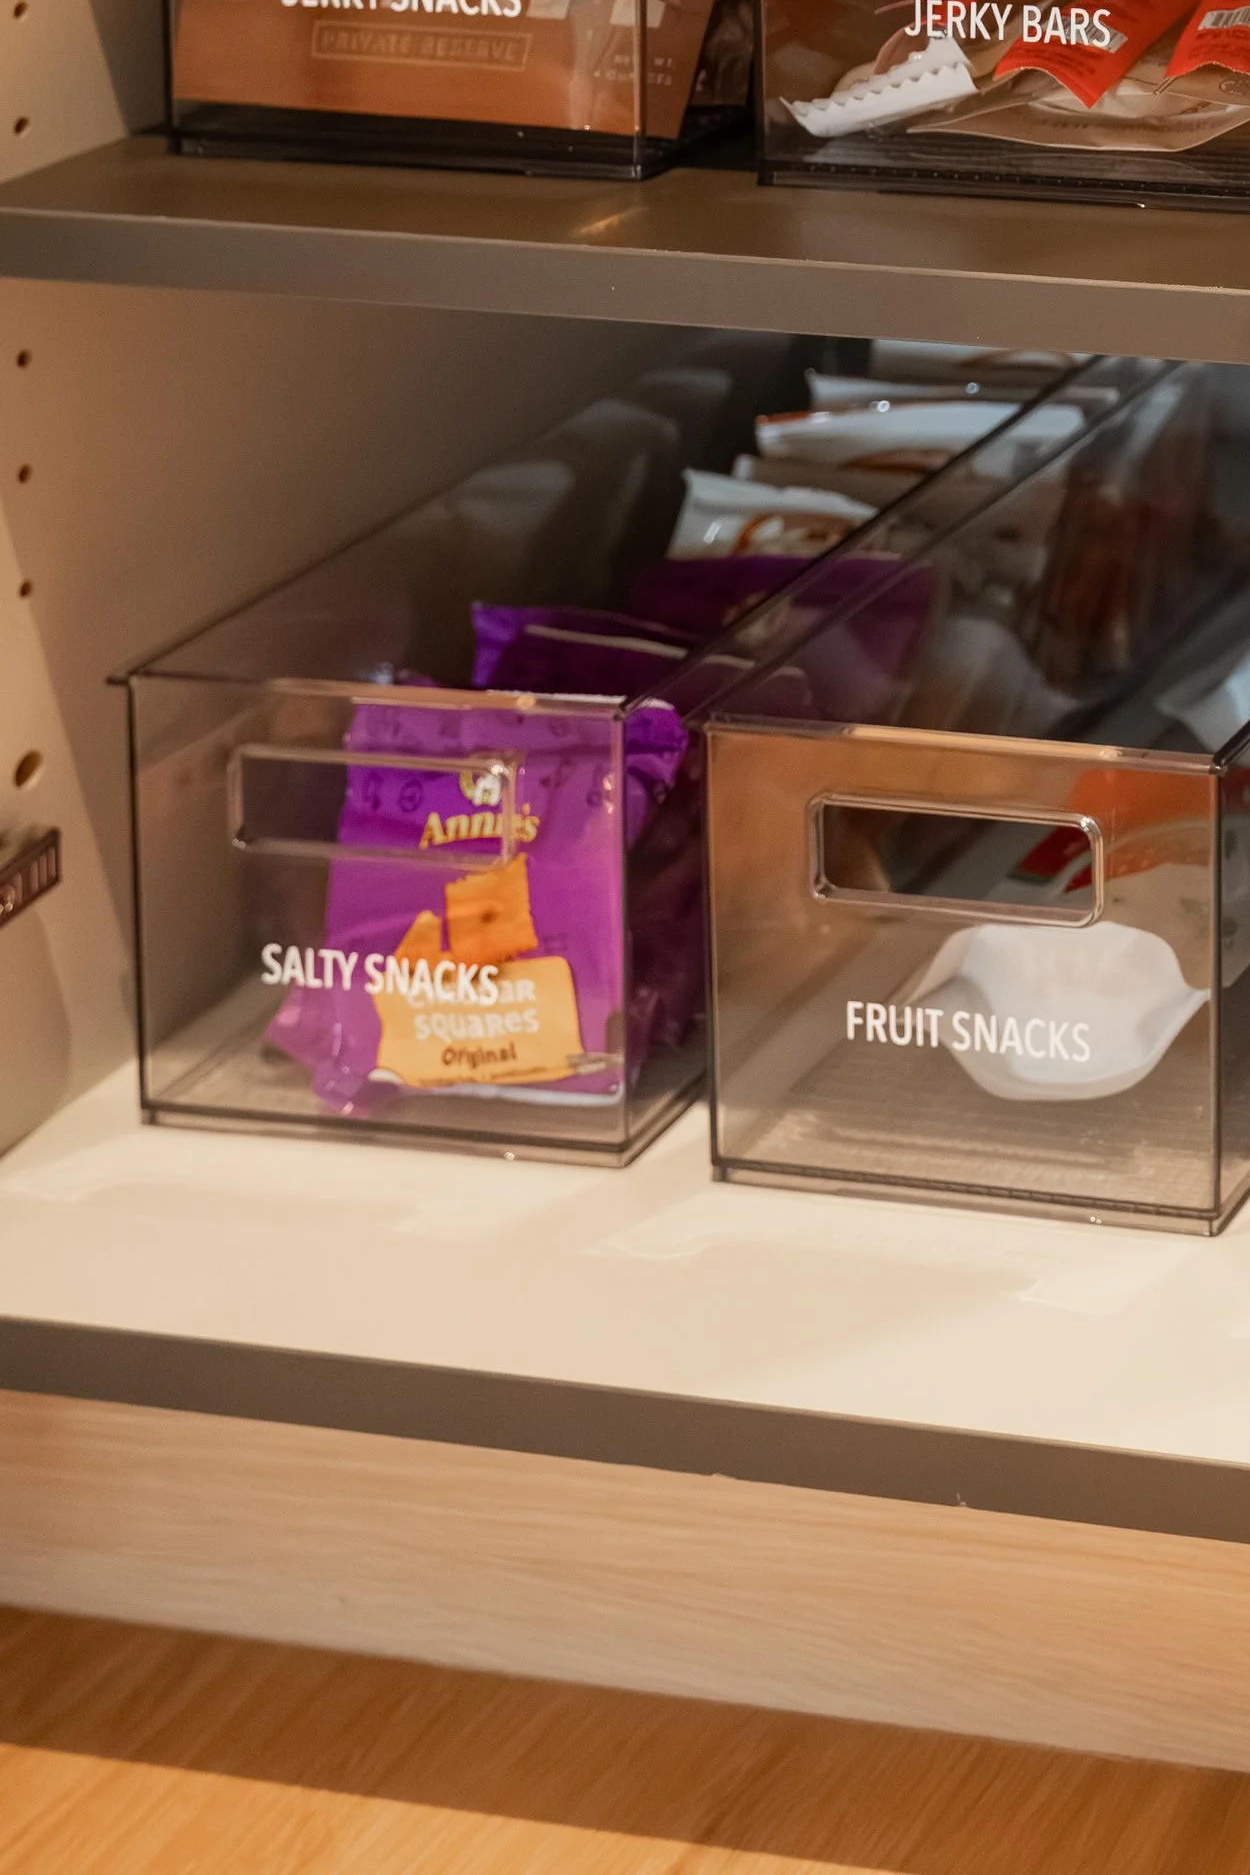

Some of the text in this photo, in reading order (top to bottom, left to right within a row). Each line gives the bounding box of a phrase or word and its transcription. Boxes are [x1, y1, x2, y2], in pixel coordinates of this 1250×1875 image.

[1022, 4, 1112, 48] BARS
[418, 803, 539, 849] Annie's
[260, 943, 359, 992] SALTY
[364, 953, 500, 1006] SNACKS
[845, 1001, 1091, 1063] FRUIT SNACKS
